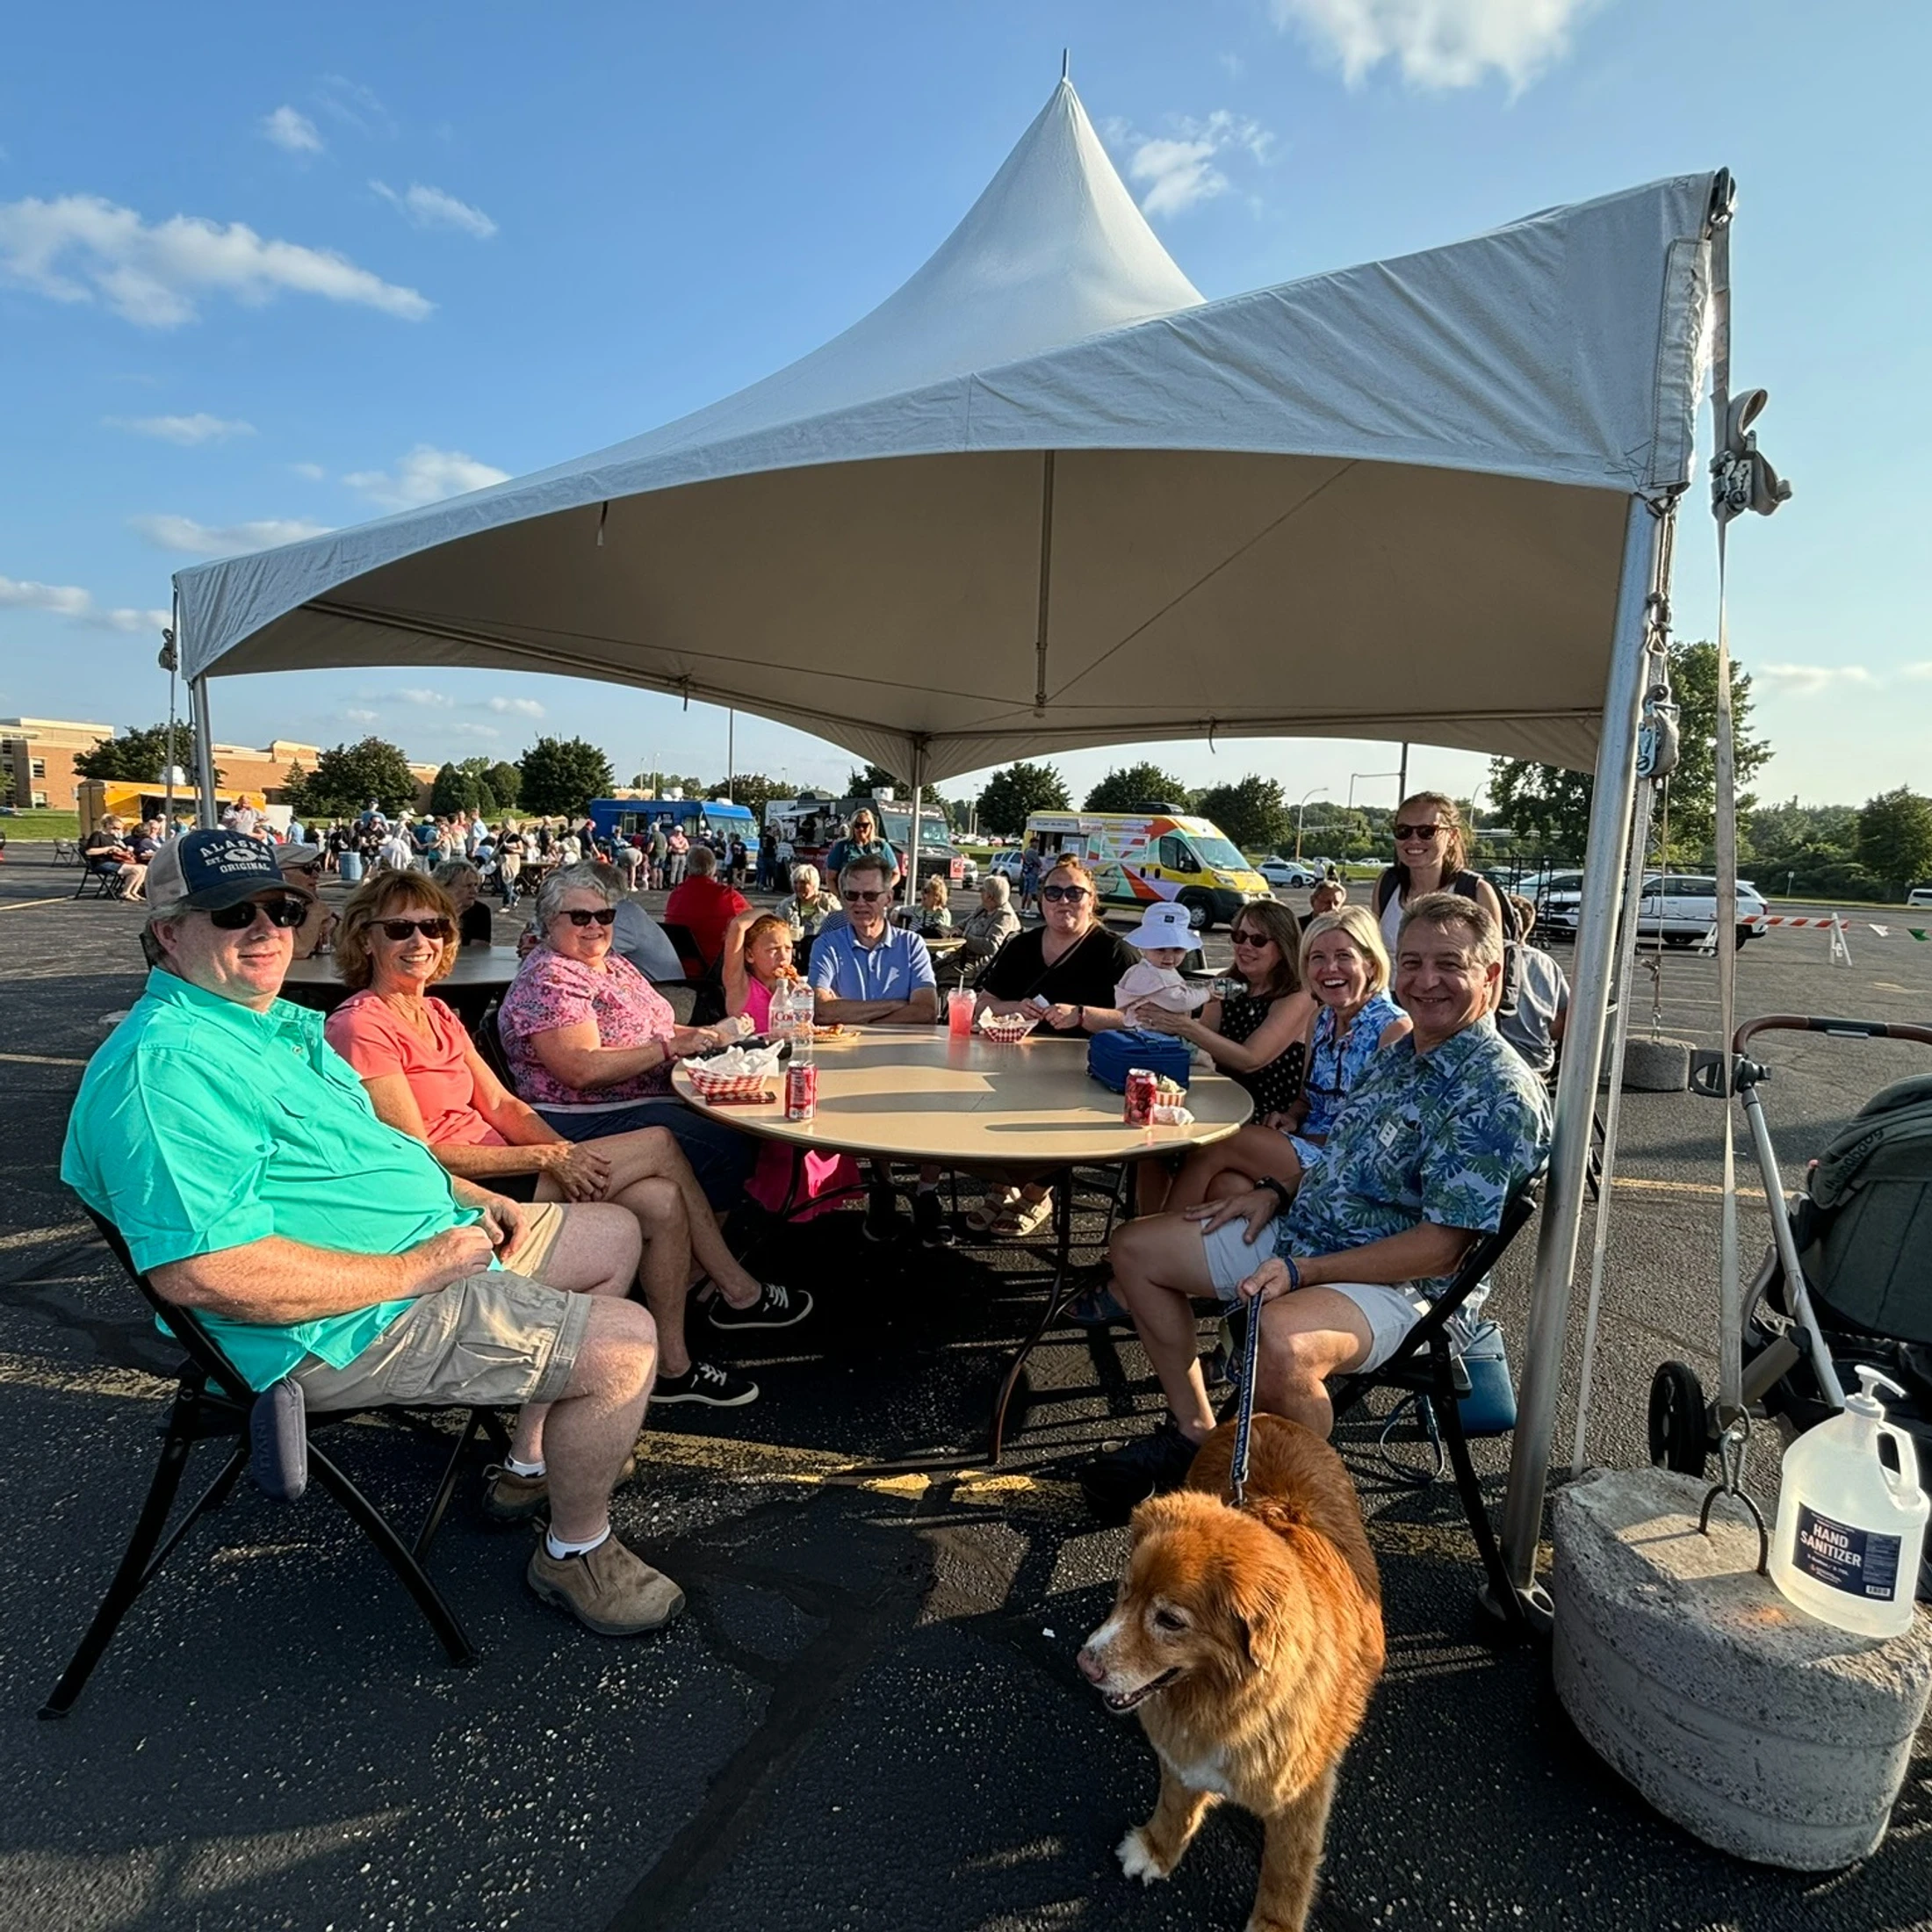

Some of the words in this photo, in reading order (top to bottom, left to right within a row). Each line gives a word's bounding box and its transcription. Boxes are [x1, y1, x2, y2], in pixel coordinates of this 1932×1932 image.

[200, 840, 270, 857] ALASKA
[219, 862, 271, 873] ORIGINAL
[1813, 1524, 1849, 1548] HAND
[1800, 1530, 1862, 1567] SANITIZER
